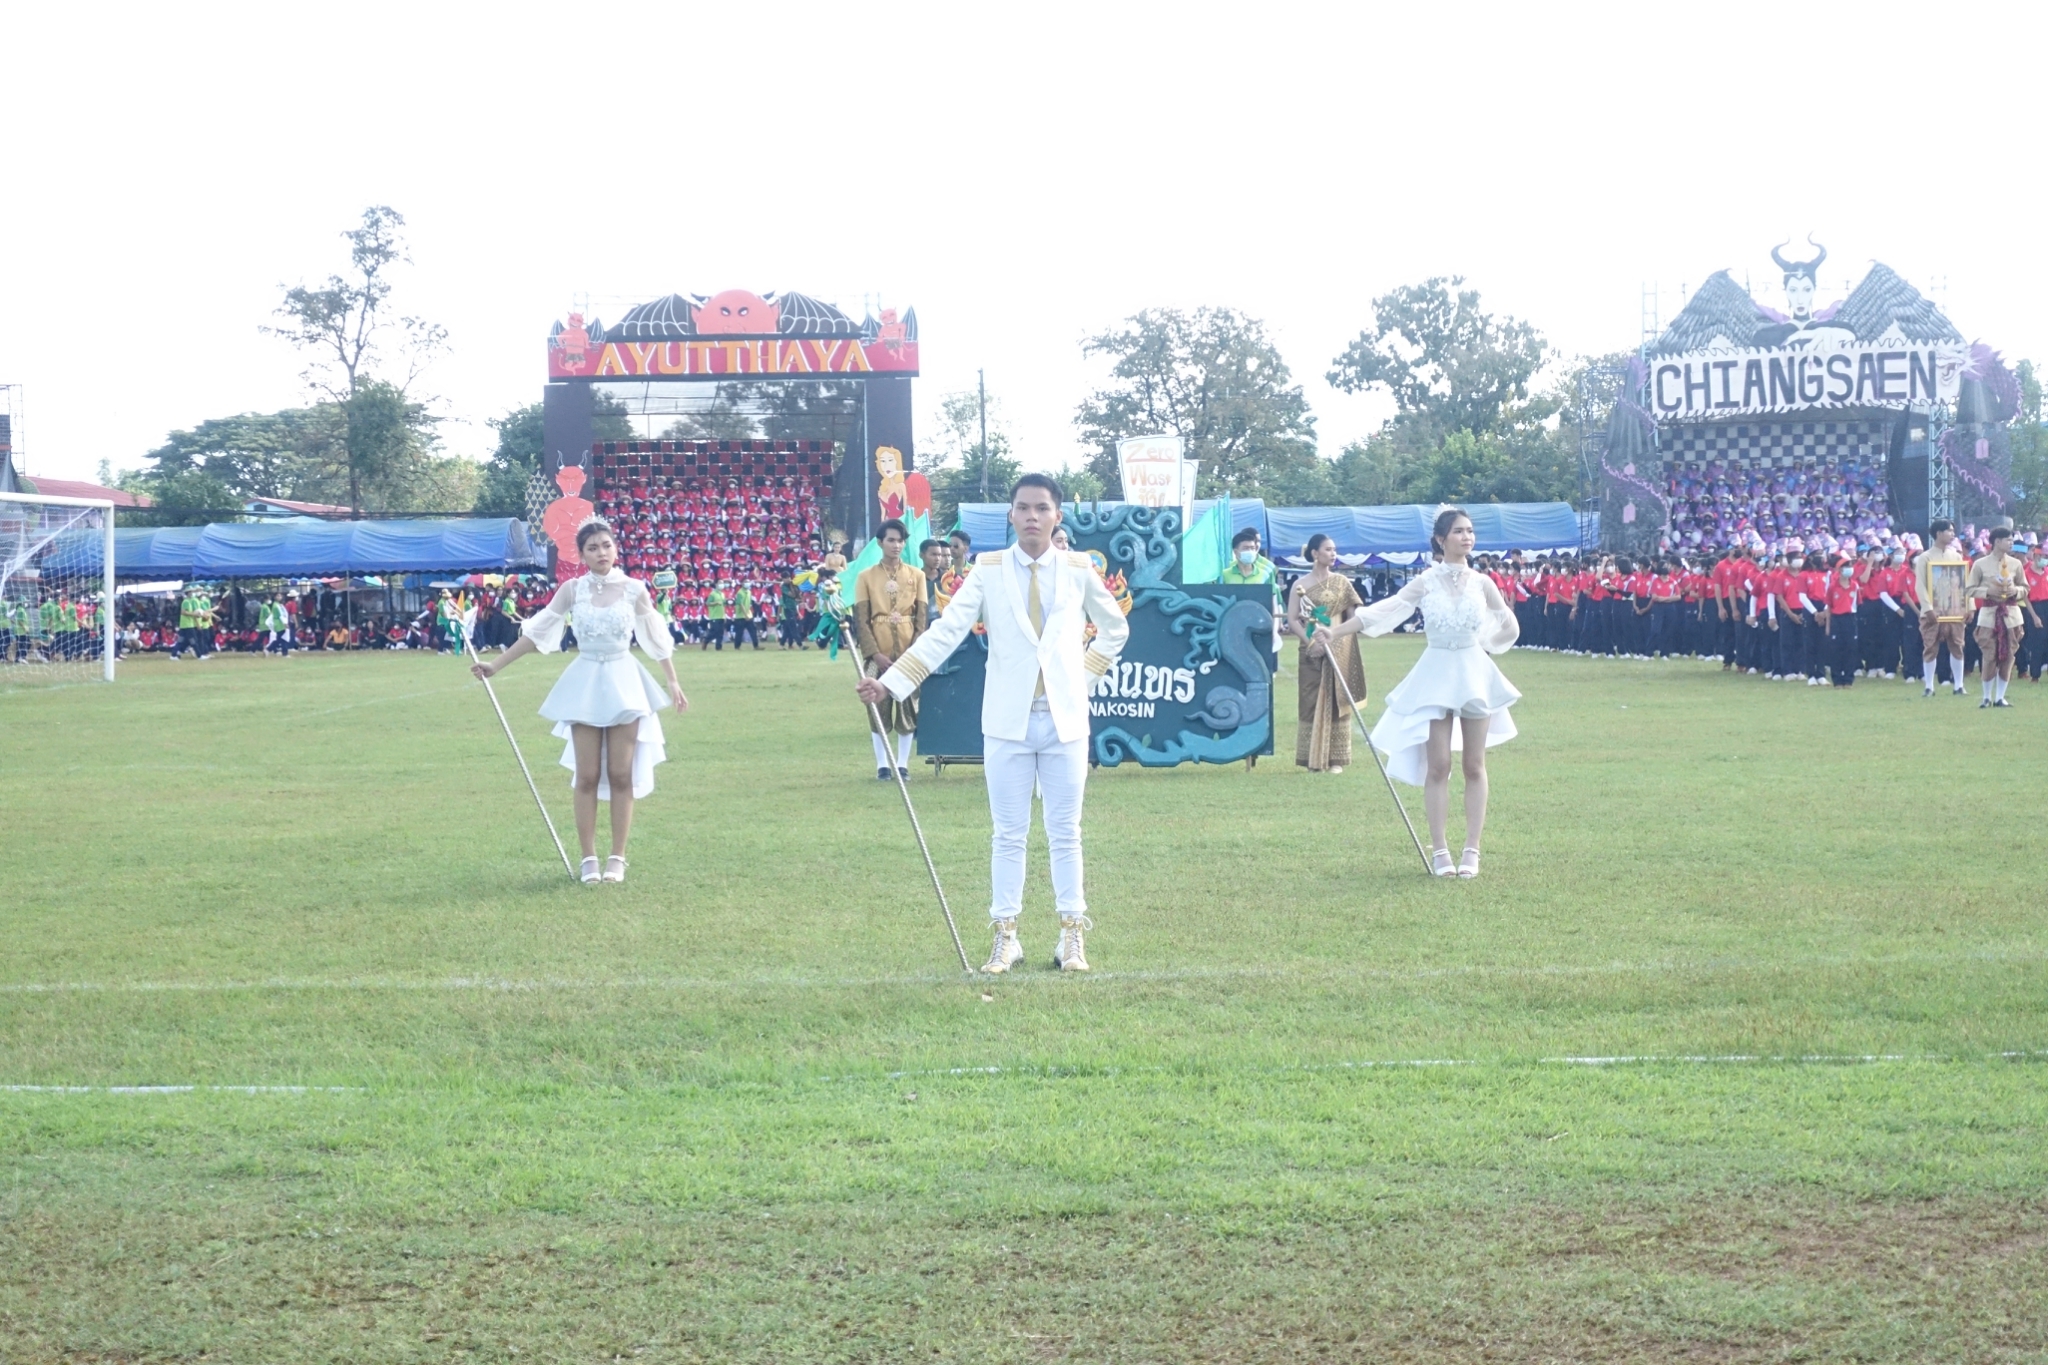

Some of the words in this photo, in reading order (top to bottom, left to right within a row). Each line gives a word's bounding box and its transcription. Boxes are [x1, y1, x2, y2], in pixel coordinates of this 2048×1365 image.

[595, 339, 872, 376] AYUTTHAYA
[1656, 350, 1937, 412] CHIANGSAEN
[1125, 442, 1176, 463] Zero
